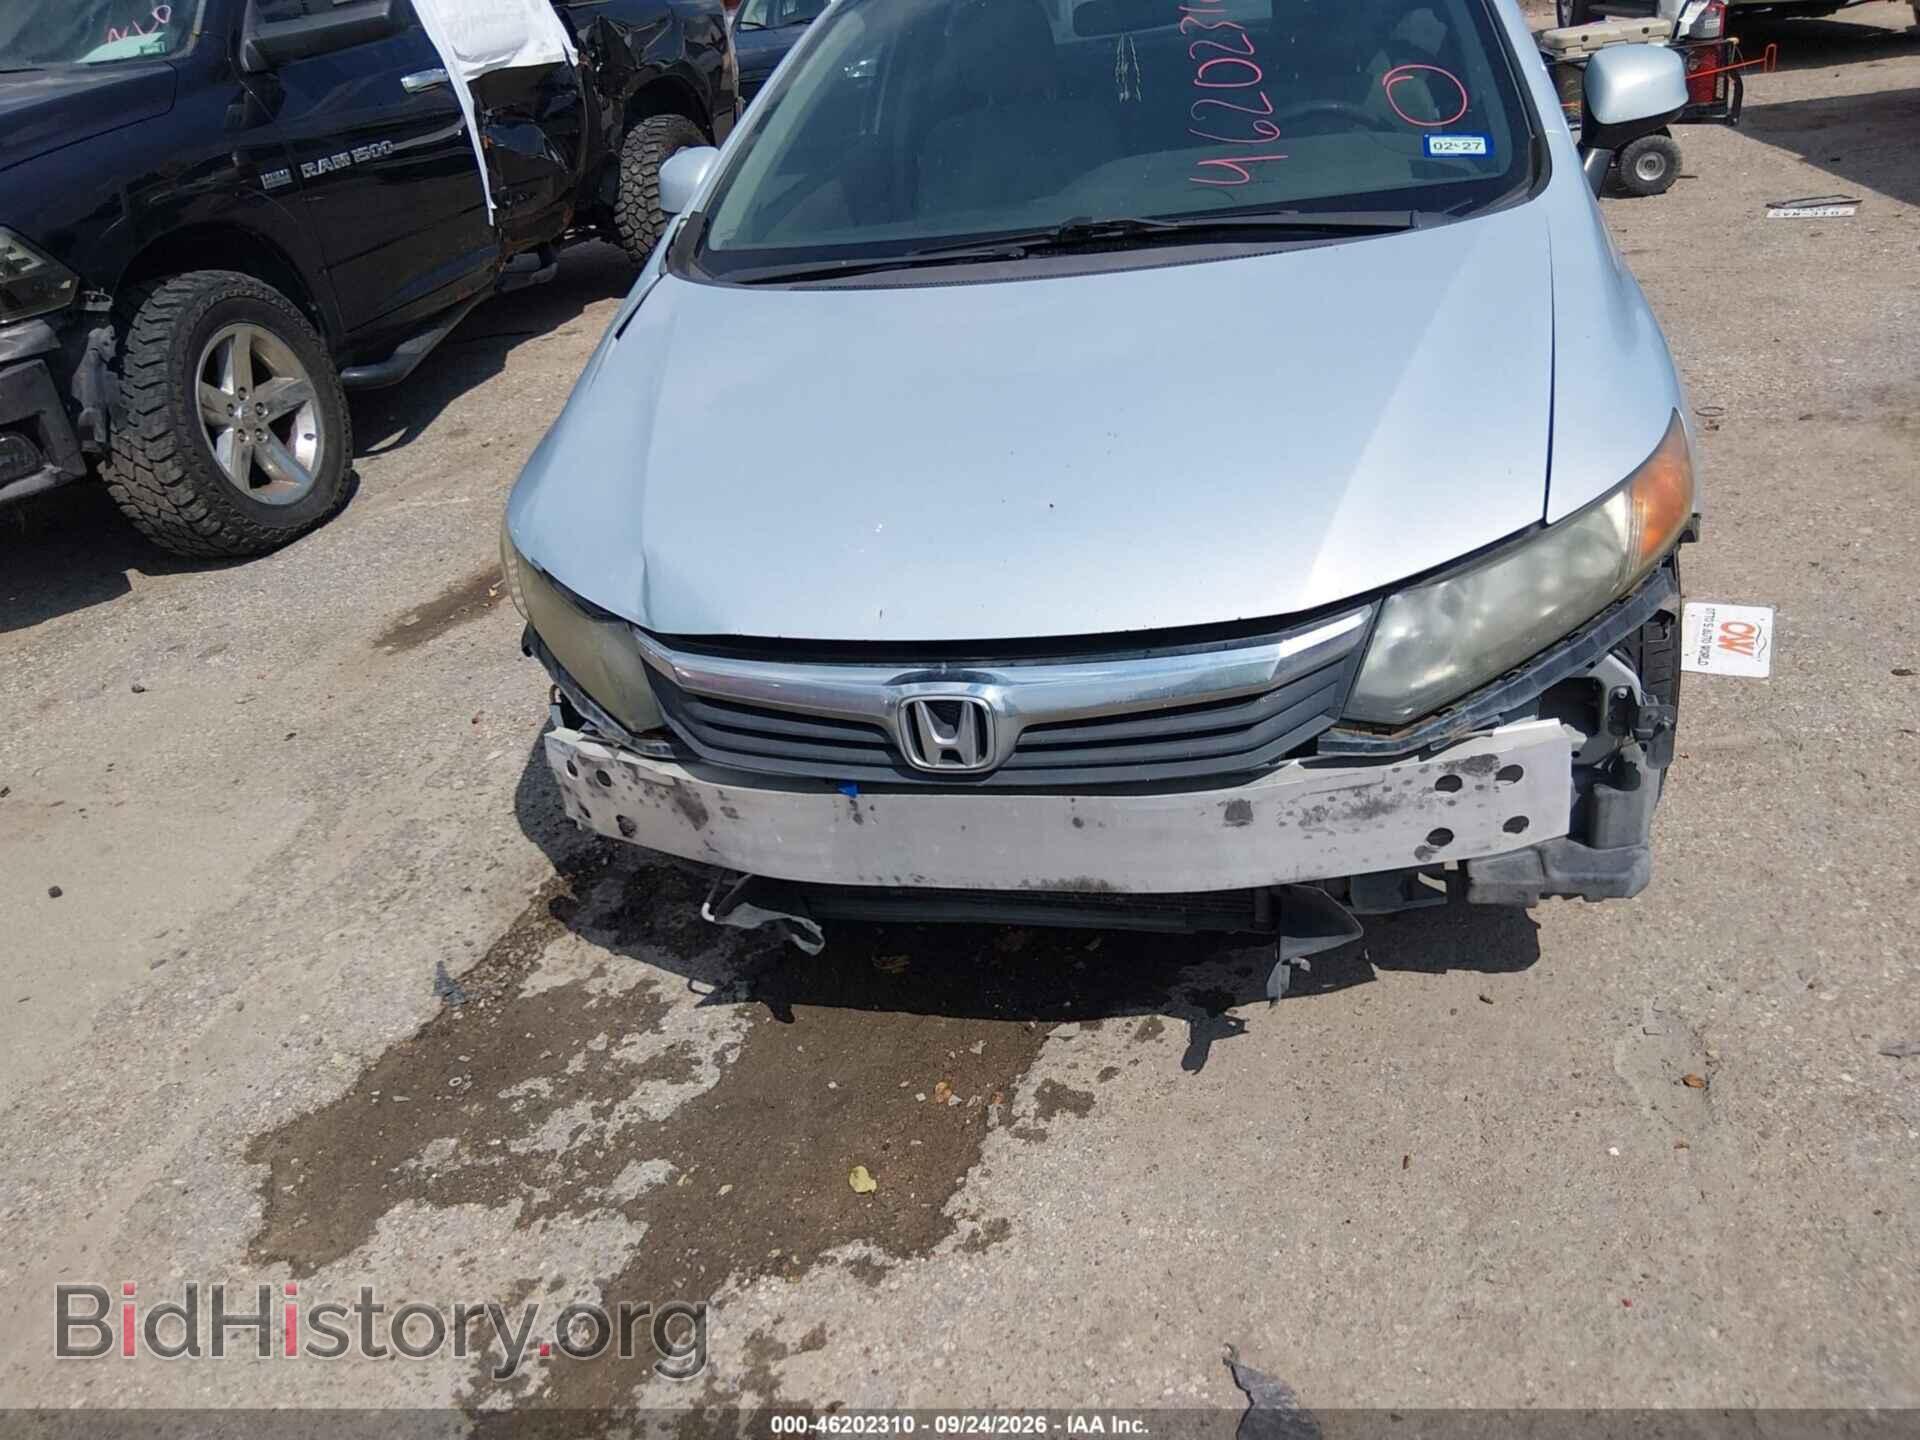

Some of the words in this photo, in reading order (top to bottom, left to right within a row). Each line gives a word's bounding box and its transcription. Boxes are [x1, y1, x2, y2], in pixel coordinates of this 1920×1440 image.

[1179, 0, 1289, 185] 4620231
[300, 152, 351, 178] RAM
[352, 140, 393, 163] 1500
